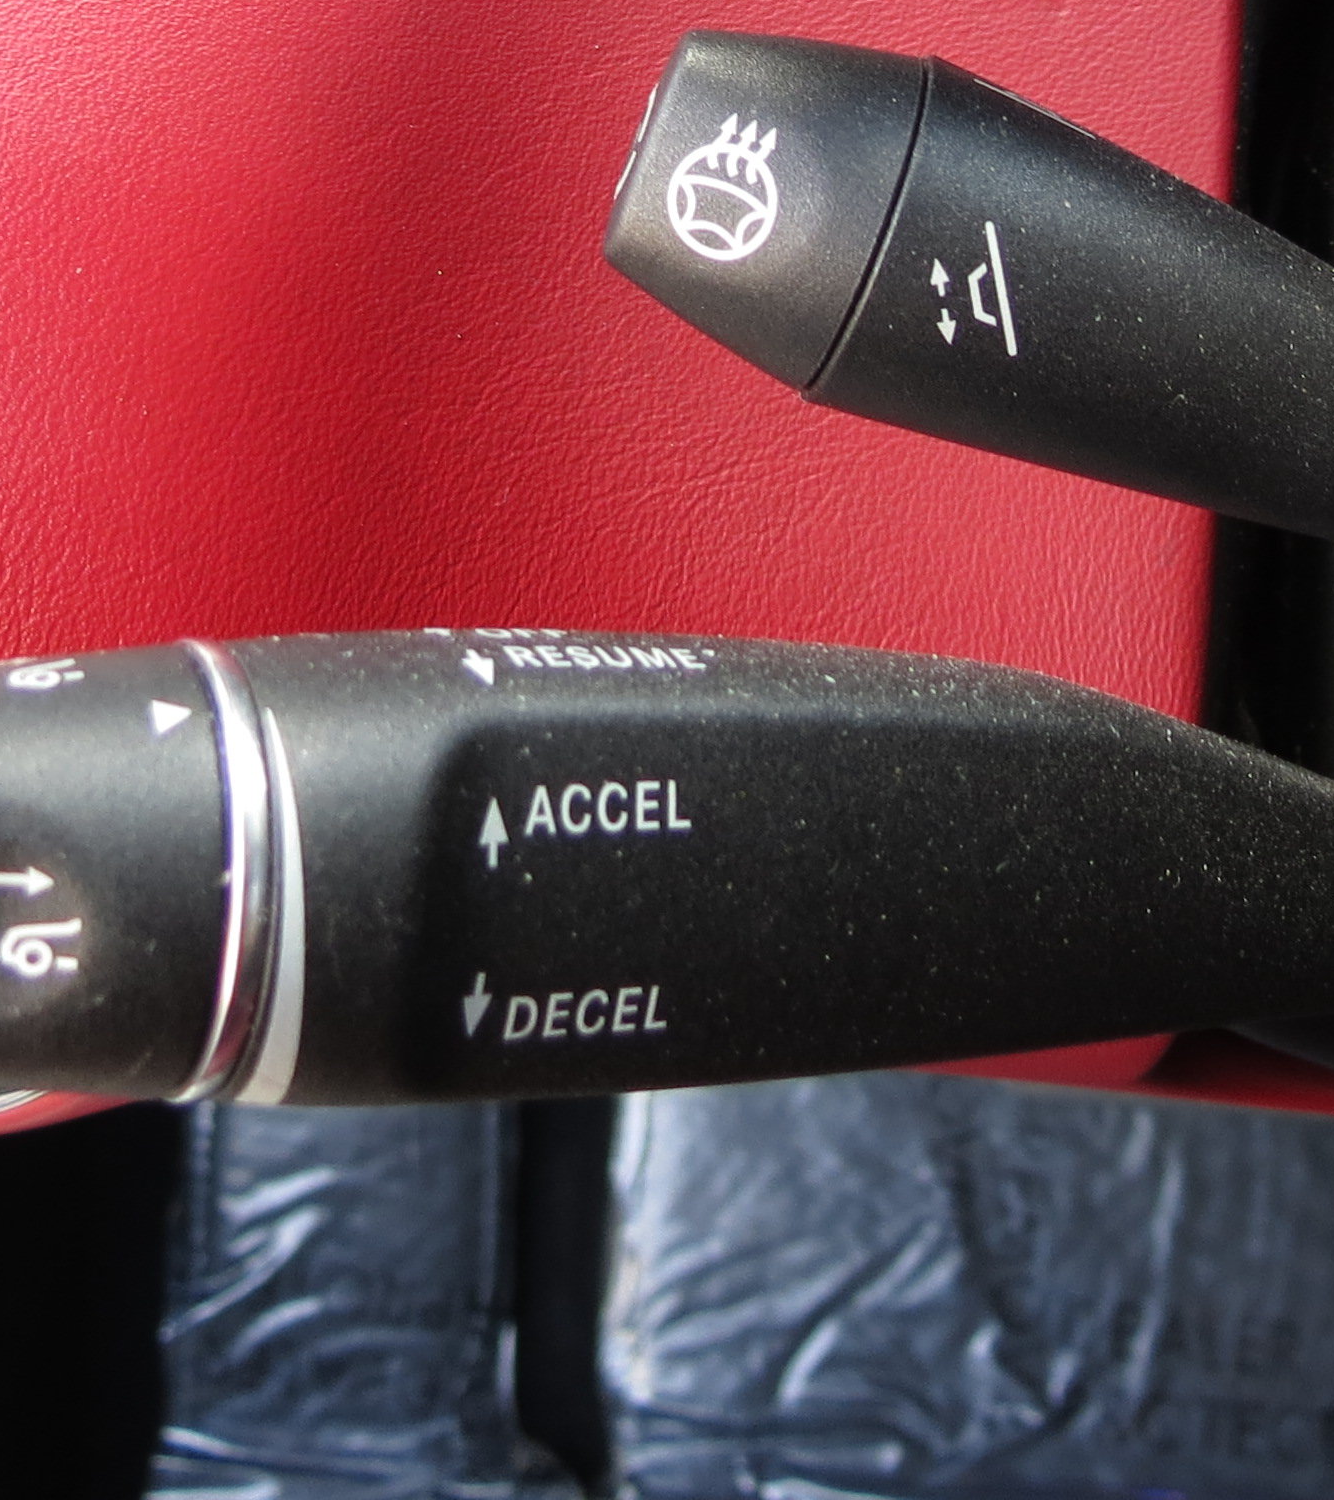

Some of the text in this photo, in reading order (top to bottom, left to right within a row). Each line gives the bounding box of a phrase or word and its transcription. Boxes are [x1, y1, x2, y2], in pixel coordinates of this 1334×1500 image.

[502, 645, 707, 670] RESUME
[524, 779, 692, 837] ACCEL
[503, 985, 667, 1041] DECEL
